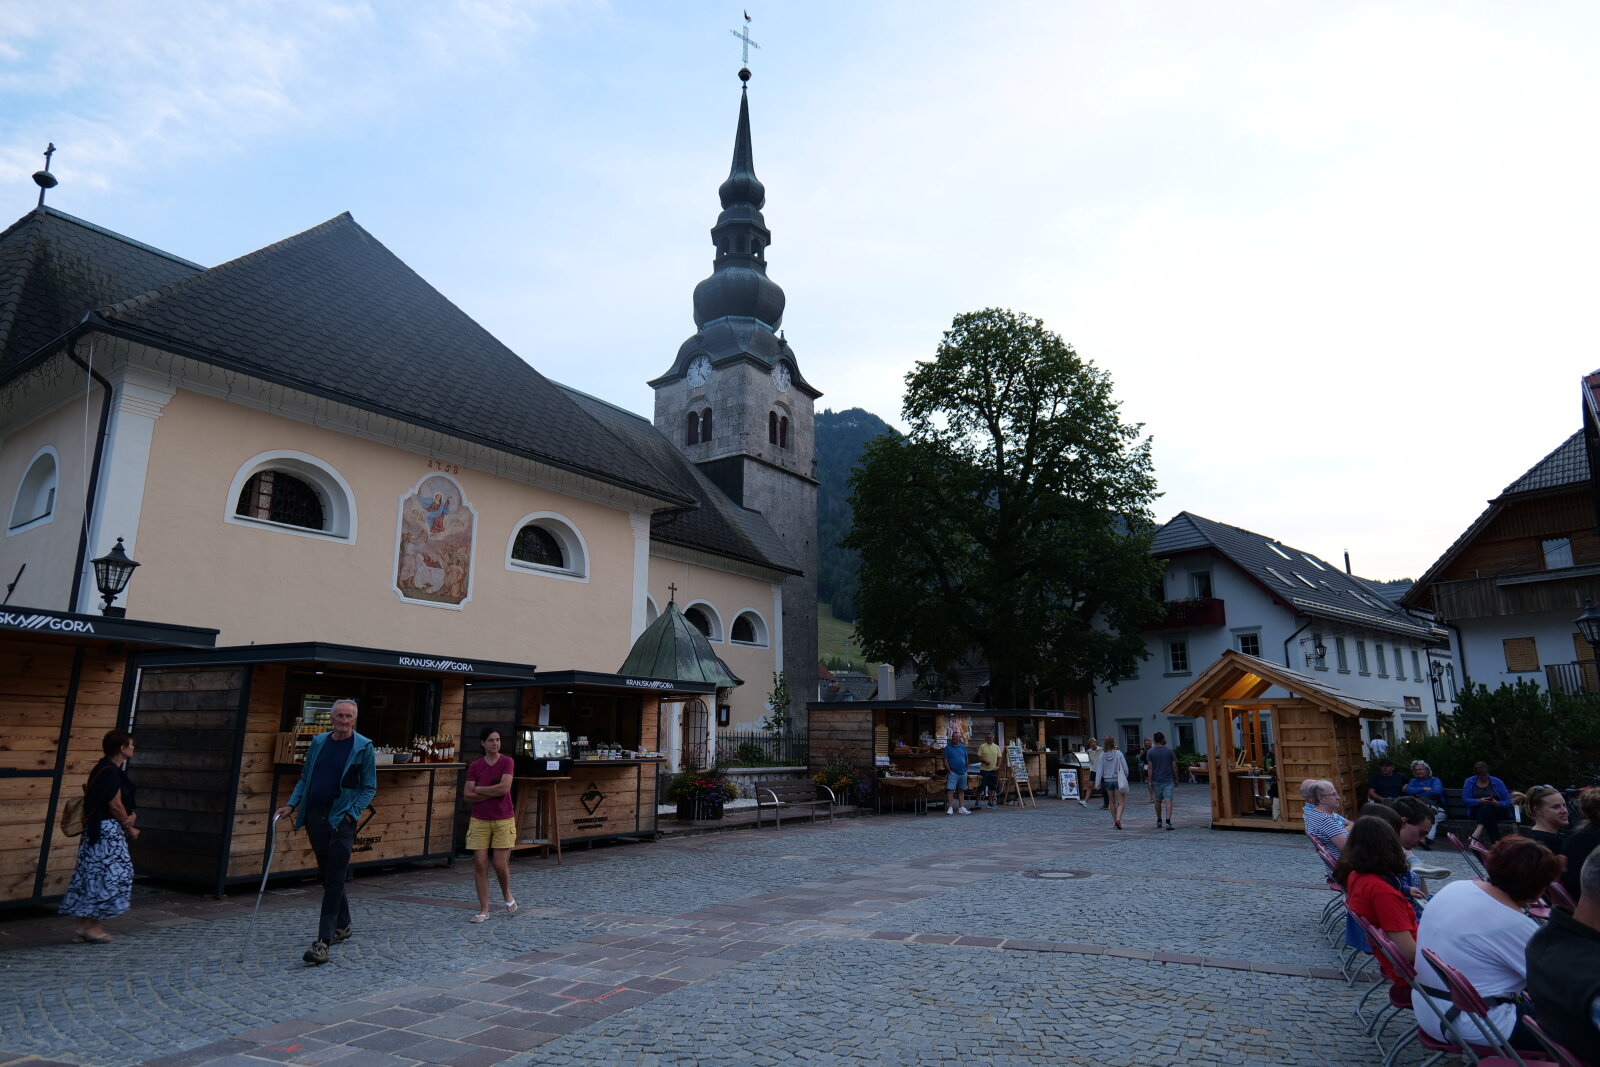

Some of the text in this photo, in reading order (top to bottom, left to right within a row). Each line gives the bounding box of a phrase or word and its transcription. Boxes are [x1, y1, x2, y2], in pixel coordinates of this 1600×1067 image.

[50, 618, 95, 633] GORA
[399, 657, 474, 672] KRANJSKA GORA
[626, 679, 674, 689] KRANJSKA GORA
